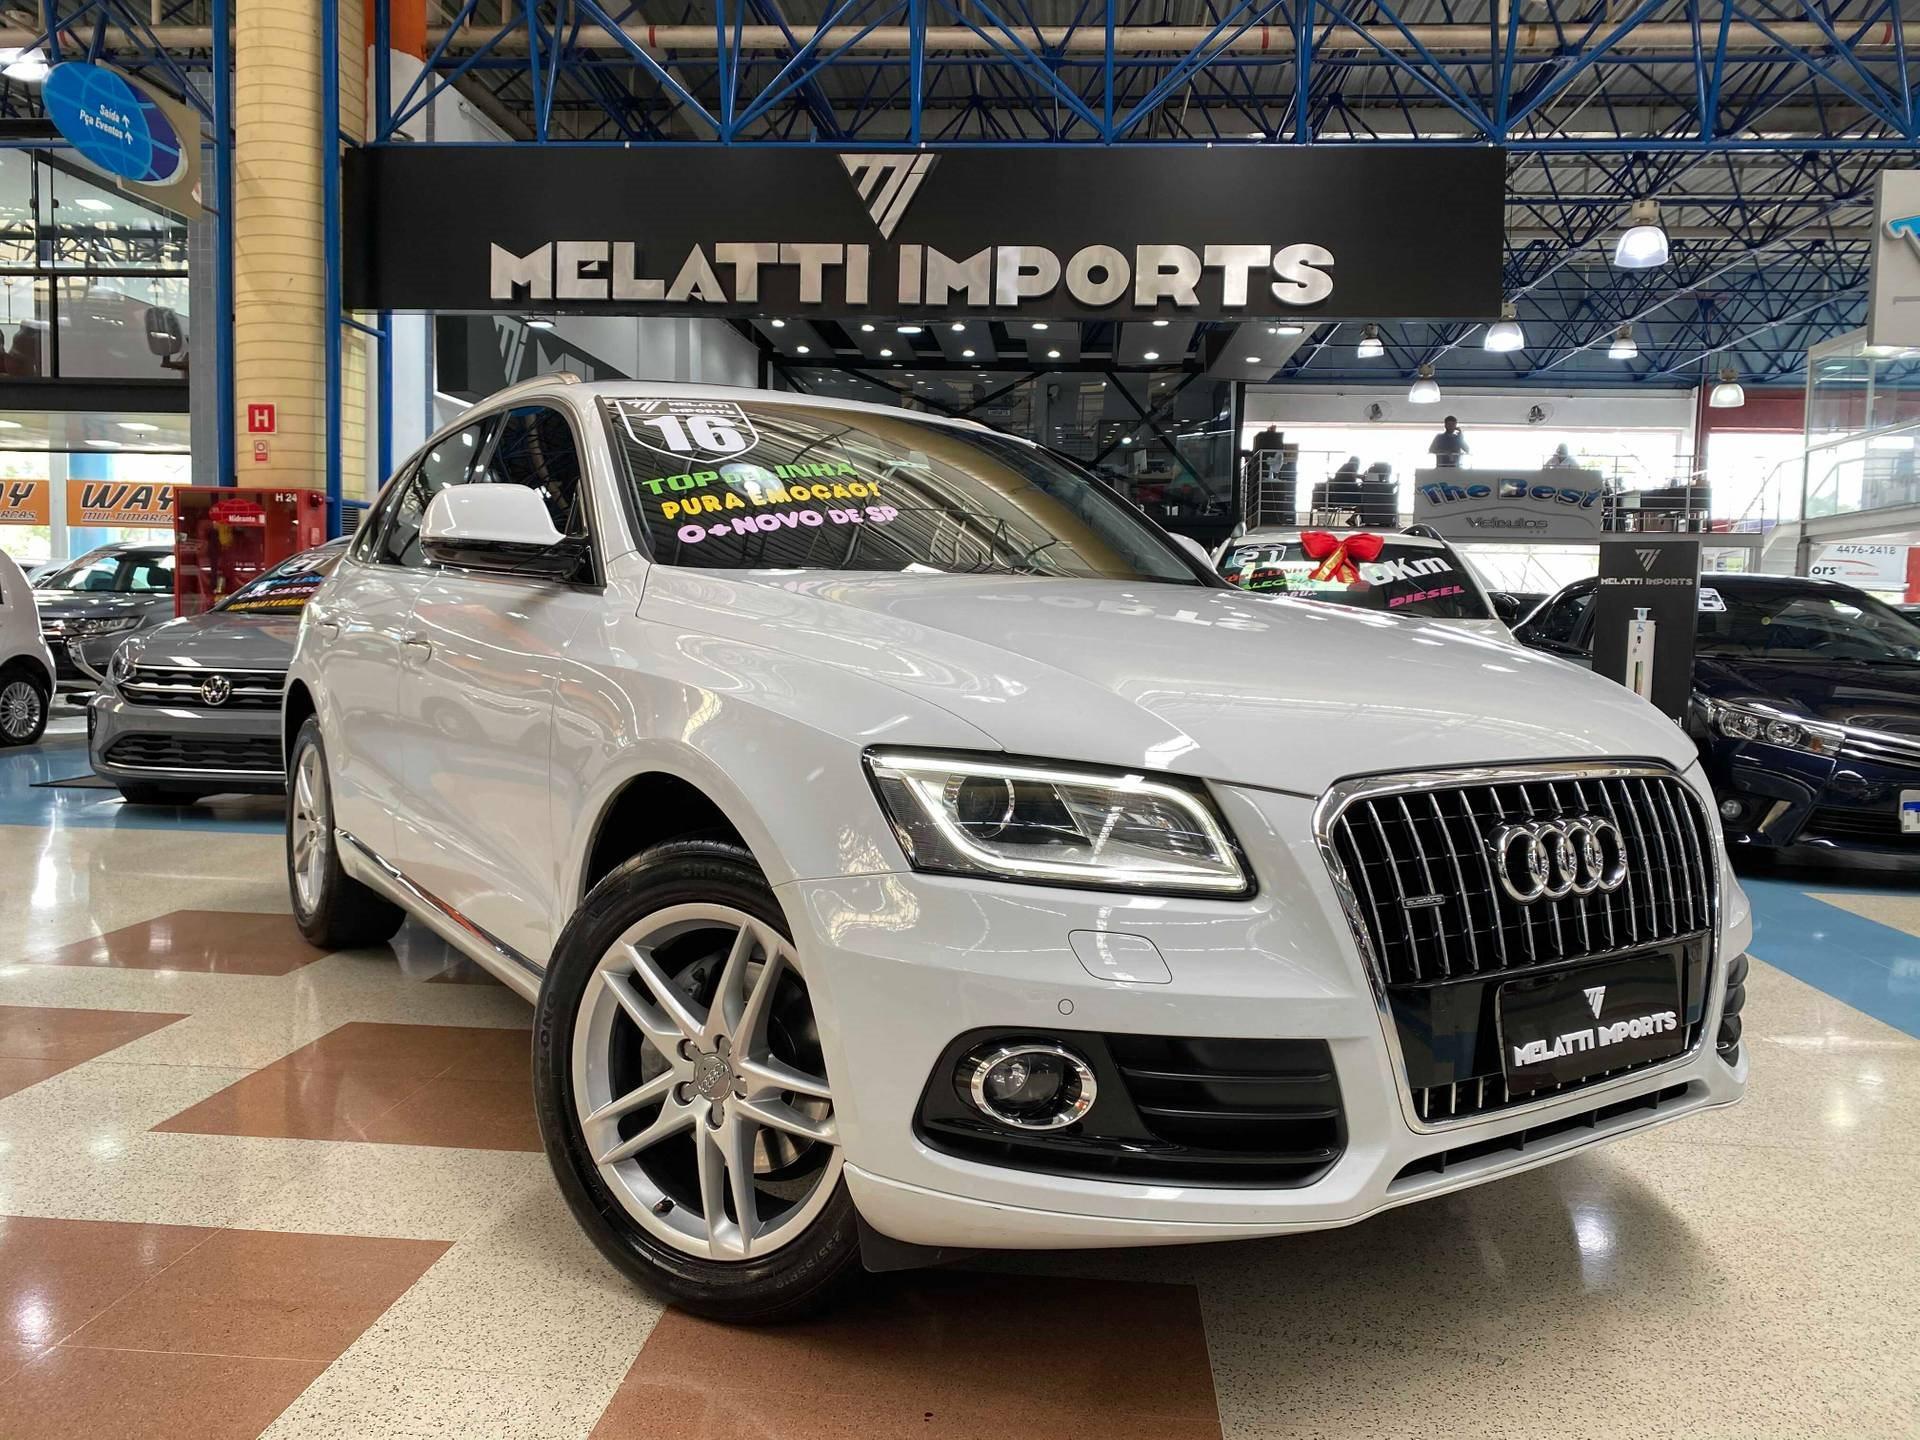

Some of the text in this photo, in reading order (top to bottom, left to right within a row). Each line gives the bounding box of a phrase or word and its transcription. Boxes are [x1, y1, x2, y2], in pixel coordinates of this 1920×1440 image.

[80, 109, 124, 139] Pça Eventos
[100, 104, 120, 124] Saída
[490, 240, 1336, 307] MELATTI IMPORTS
[254, 409, 269, 428] H
[643, 415, 747, 452] 16
[642, 470, 720, 495] TOP
[1416, 478, 1601, 510] The Best
[81, 482, 174, 512] WAY
[285, 493, 298, 502] 24
[661, 492, 745, 520] PURA
[828, 508, 864, 525] DE
[865, 505, 898, 522] SP
[1600, 577, 1694, 586] MELATTI IMPORTS
[1389, 585, 1465, 608] DIESEL
[1513, 1011, 1678, 1067] MELATTI IMPORTS
